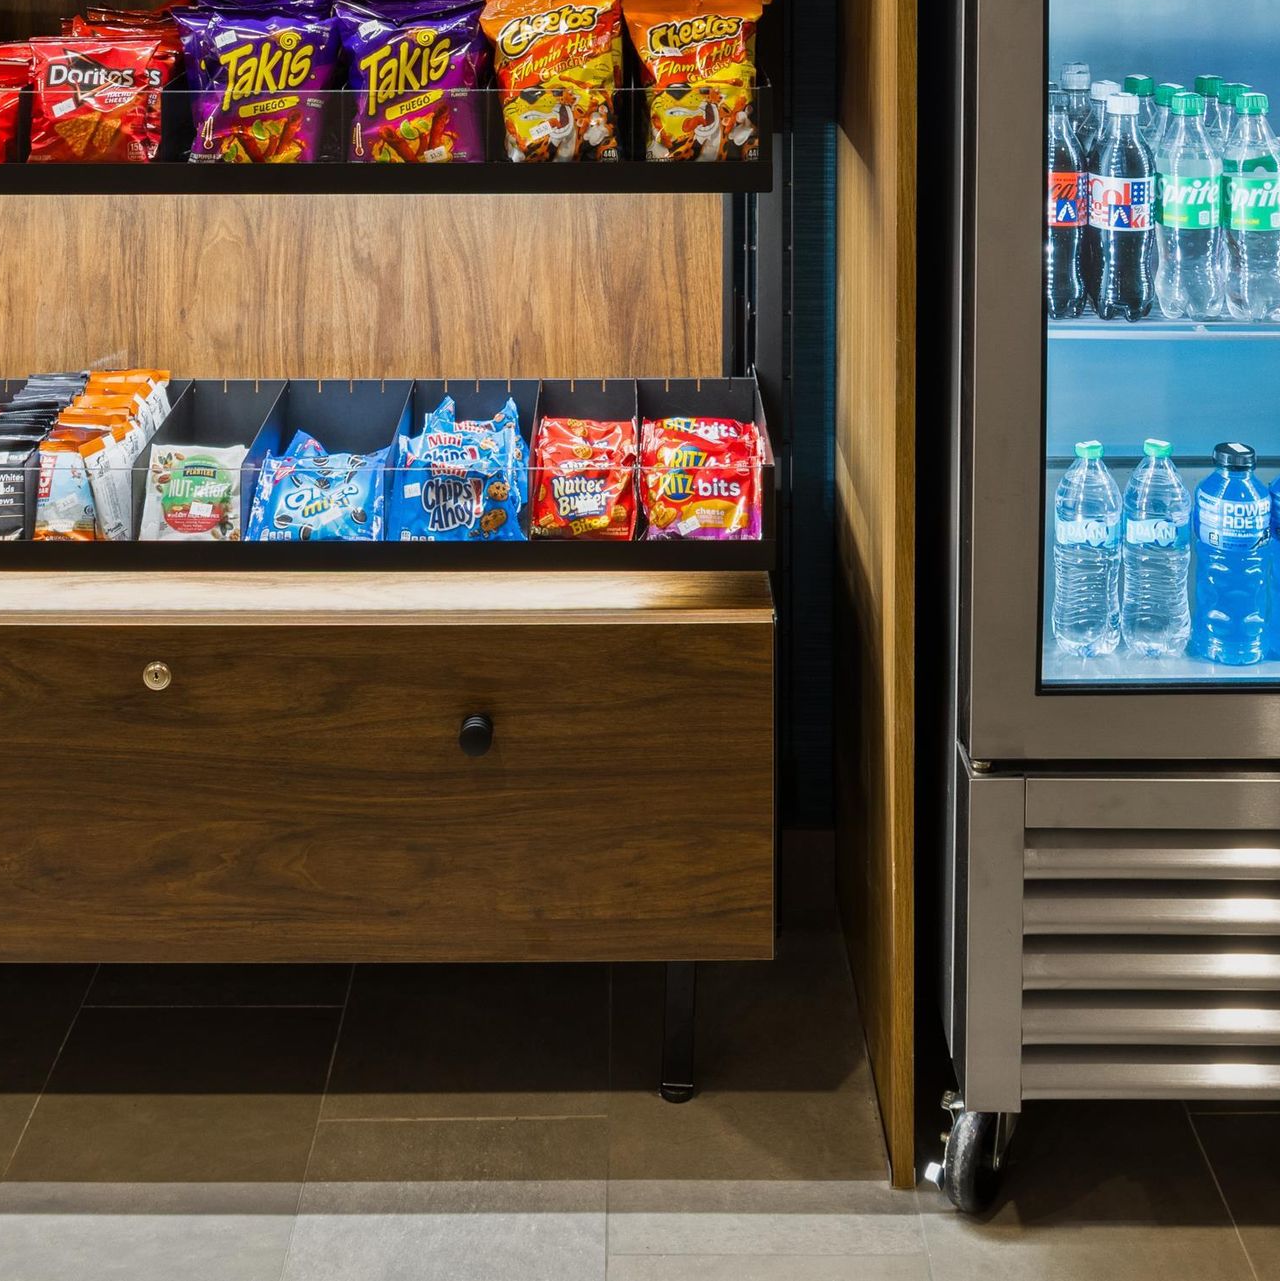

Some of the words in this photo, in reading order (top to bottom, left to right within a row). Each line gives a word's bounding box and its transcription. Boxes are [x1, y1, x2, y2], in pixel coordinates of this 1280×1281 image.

[649, 15, 741, 55] Cheetos
[49, 64, 134, 87] Doritos
[220, 32, 314, 111] Takis
[360, 29, 451, 116] Takis
[253, 100, 285, 115] FUEGO
[400, 94, 432, 115] FUEGO
[423, 478, 473, 509] Chips
[552, 476, 604, 498] Nutter
[659, 473, 695, 495] RITZ
[696, 478, 741, 497] bits
